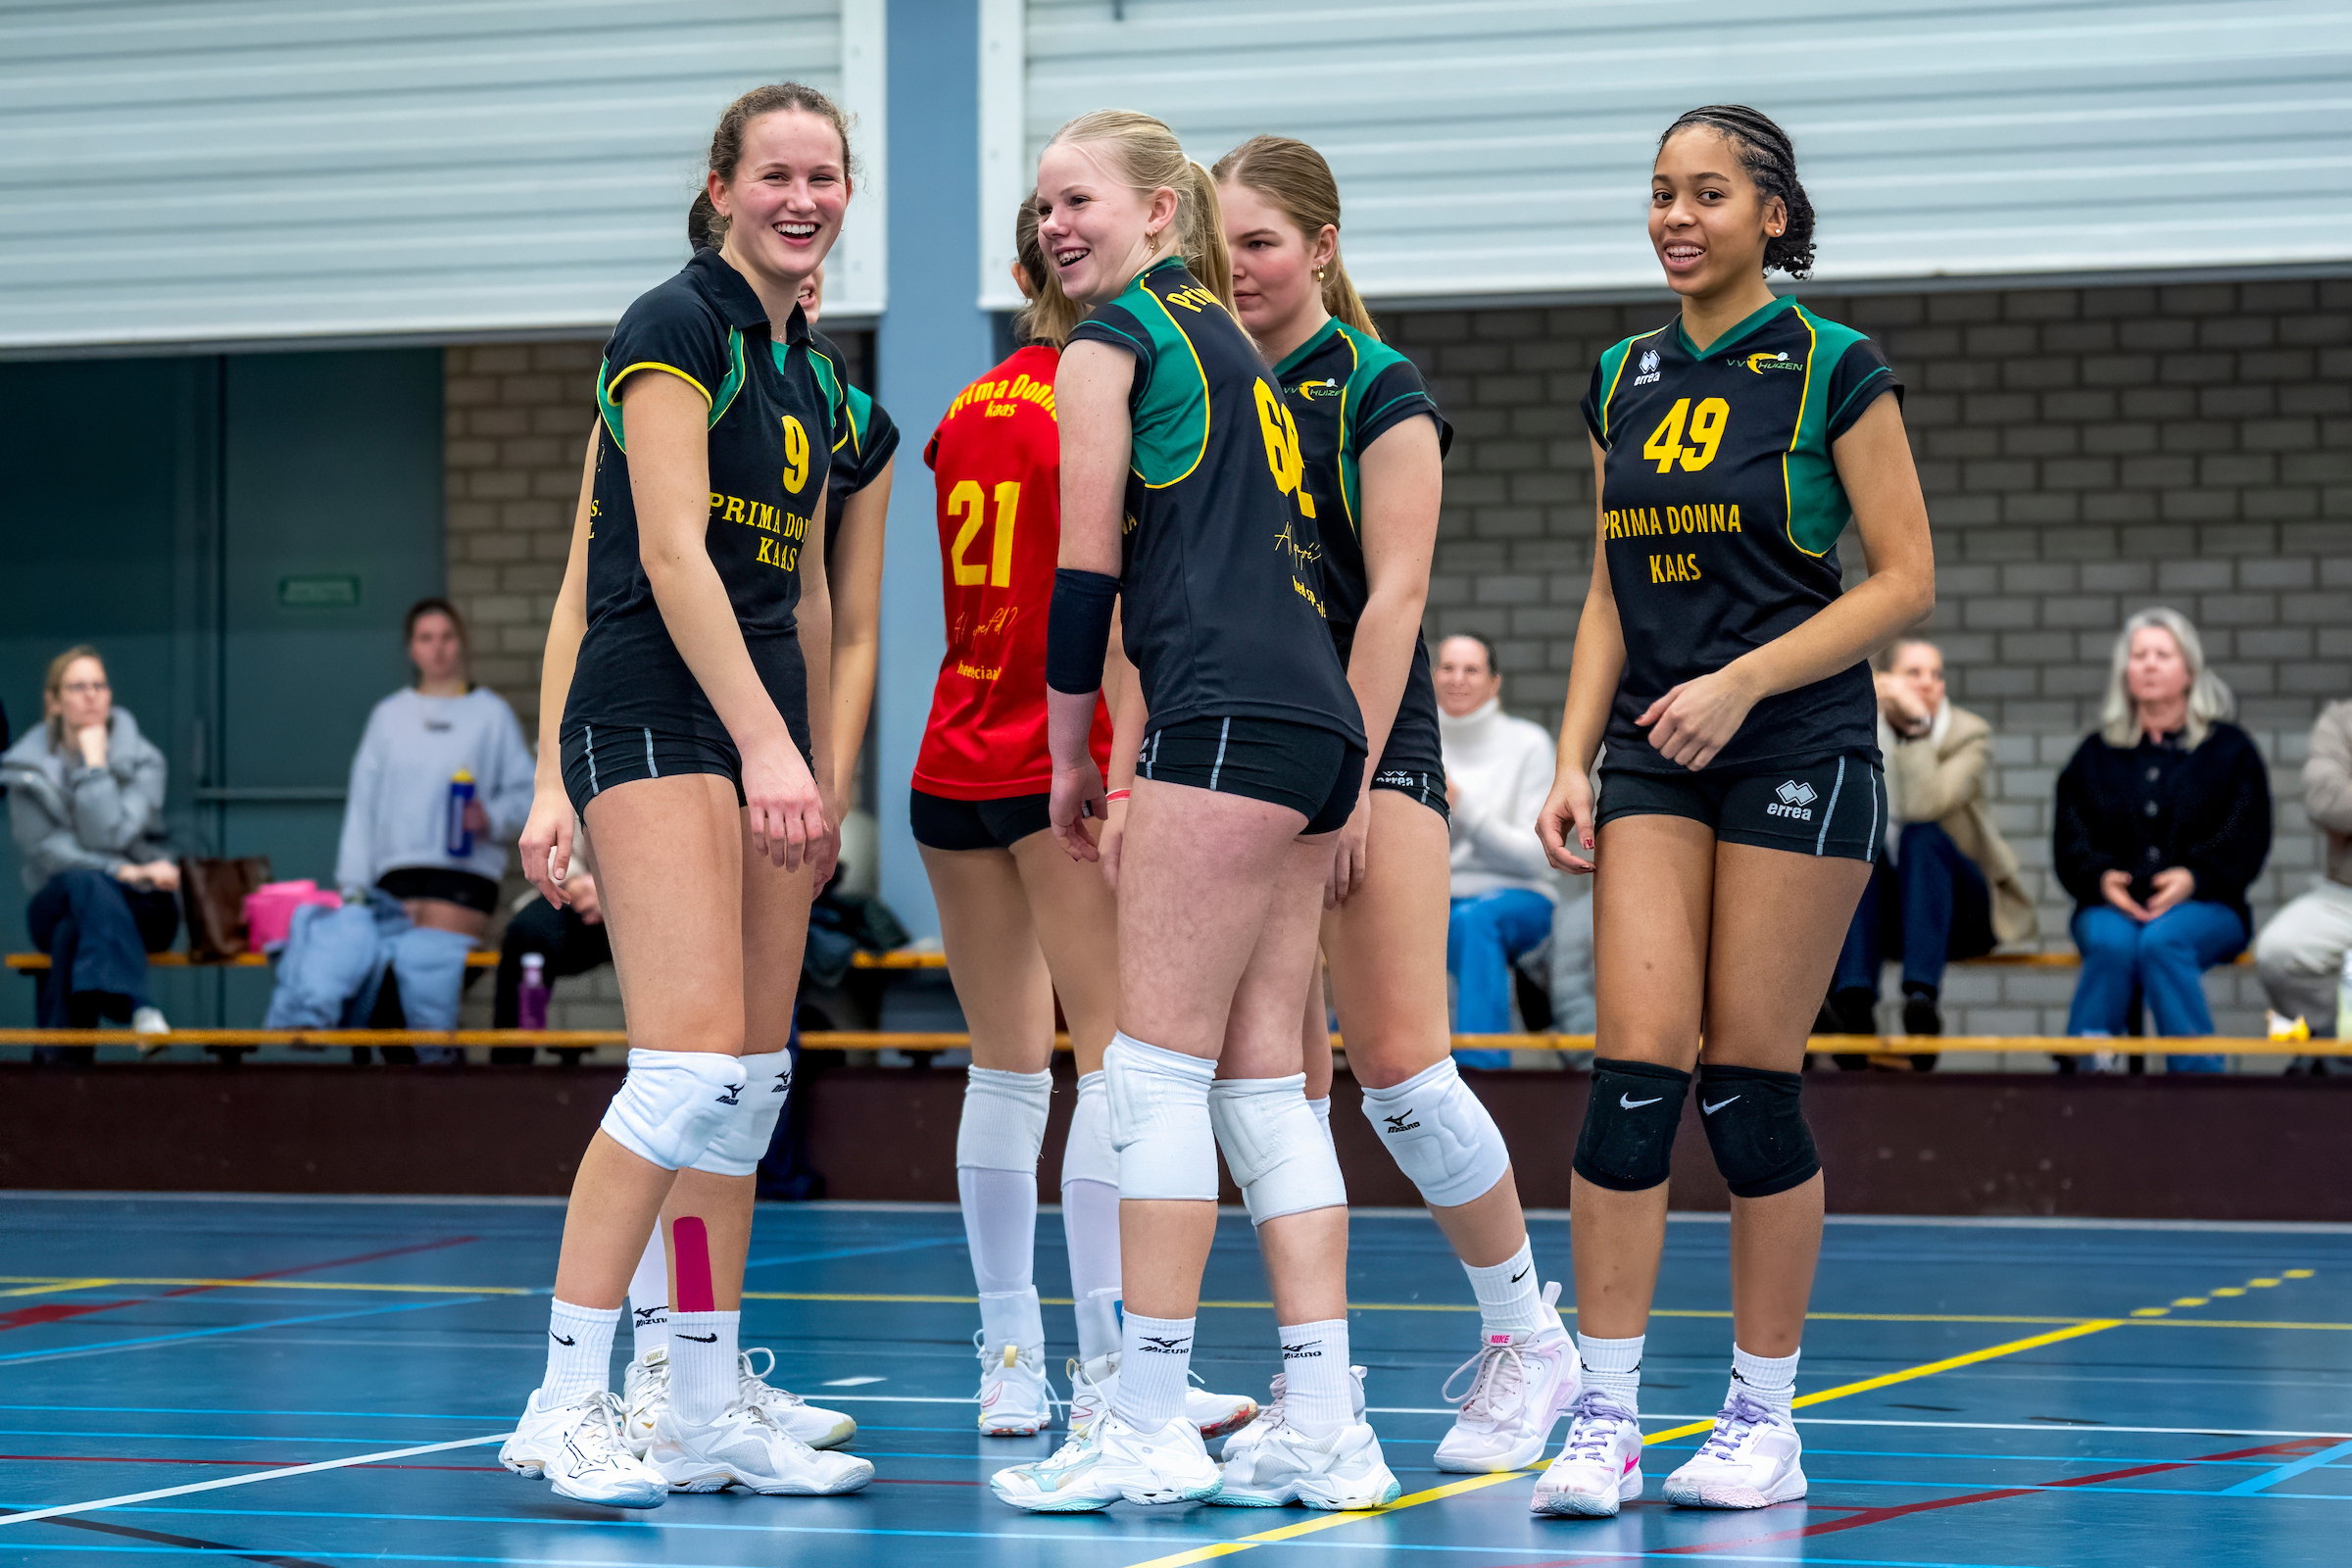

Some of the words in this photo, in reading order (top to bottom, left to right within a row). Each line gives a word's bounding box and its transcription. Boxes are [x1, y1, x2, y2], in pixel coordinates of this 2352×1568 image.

[1166, 284, 1222, 313] Prim
[1634, 371, 1661, 386] errea
[1758, 362, 1803, 371] HUIZEN
[1310, 388, 1343, 397] HUIZE
[985, 400, 1017, 417] kaas
[1642, 397, 1731, 473] 49
[781, 415, 810, 494] 9
[710, 492, 781, 534] PRIMA
[783, 513, 811, 543] DON
[1604, 507, 1663, 540] PRIMA
[1666, 504, 1741, 534] DONNA
[947, 479, 1021, 588] 21
[756, 537, 797, 572] KAAS
[1649, 554, 1701, 583] KAAS
[1767, 803, 1812, 821] errea
[1491, 1335, 1510, 1344] NIKE
[647, 1349, 665, 1362] NIKE
